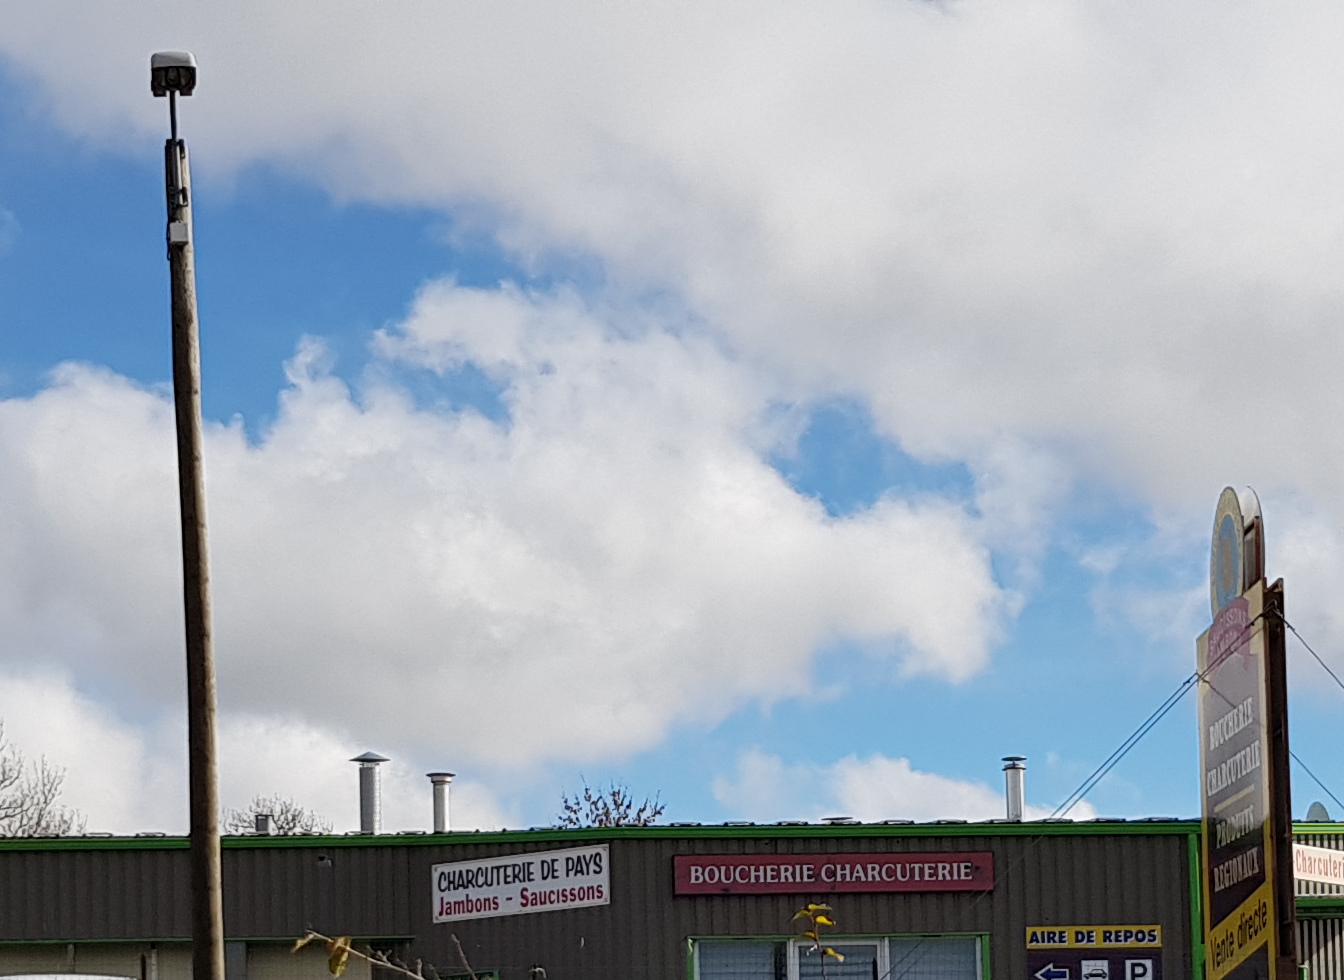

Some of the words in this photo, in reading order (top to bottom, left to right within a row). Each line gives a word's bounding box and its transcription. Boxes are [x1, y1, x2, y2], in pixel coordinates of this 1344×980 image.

[1209, 697, 1253, 751] BOUCHERIE
[1207, 740, 1260, 796] CHARCUTERIE
[1216, 805, 1254, 849] PRODUITS
[437, 861, 534, 892] CHARCUTERIE
[541, 859, 559, 881] DE
[565, 852, 603, 878] PAYS
[689, 864, 815, 884] BOUCHERIE
[820, 862, 973, 882] CHARCUTERIE
[438, 893, 499, 916] Jambons
[520, 884, 604, 907] Saucissons
[1029, 930, 1067, 945] AIRE
[1074, 930, 1096, 945] DE
[1102, 929, 1157, 945] REPOS
[1210, 929, 1234, 971] Vente
[1238, 899, 1267, 949] directe
